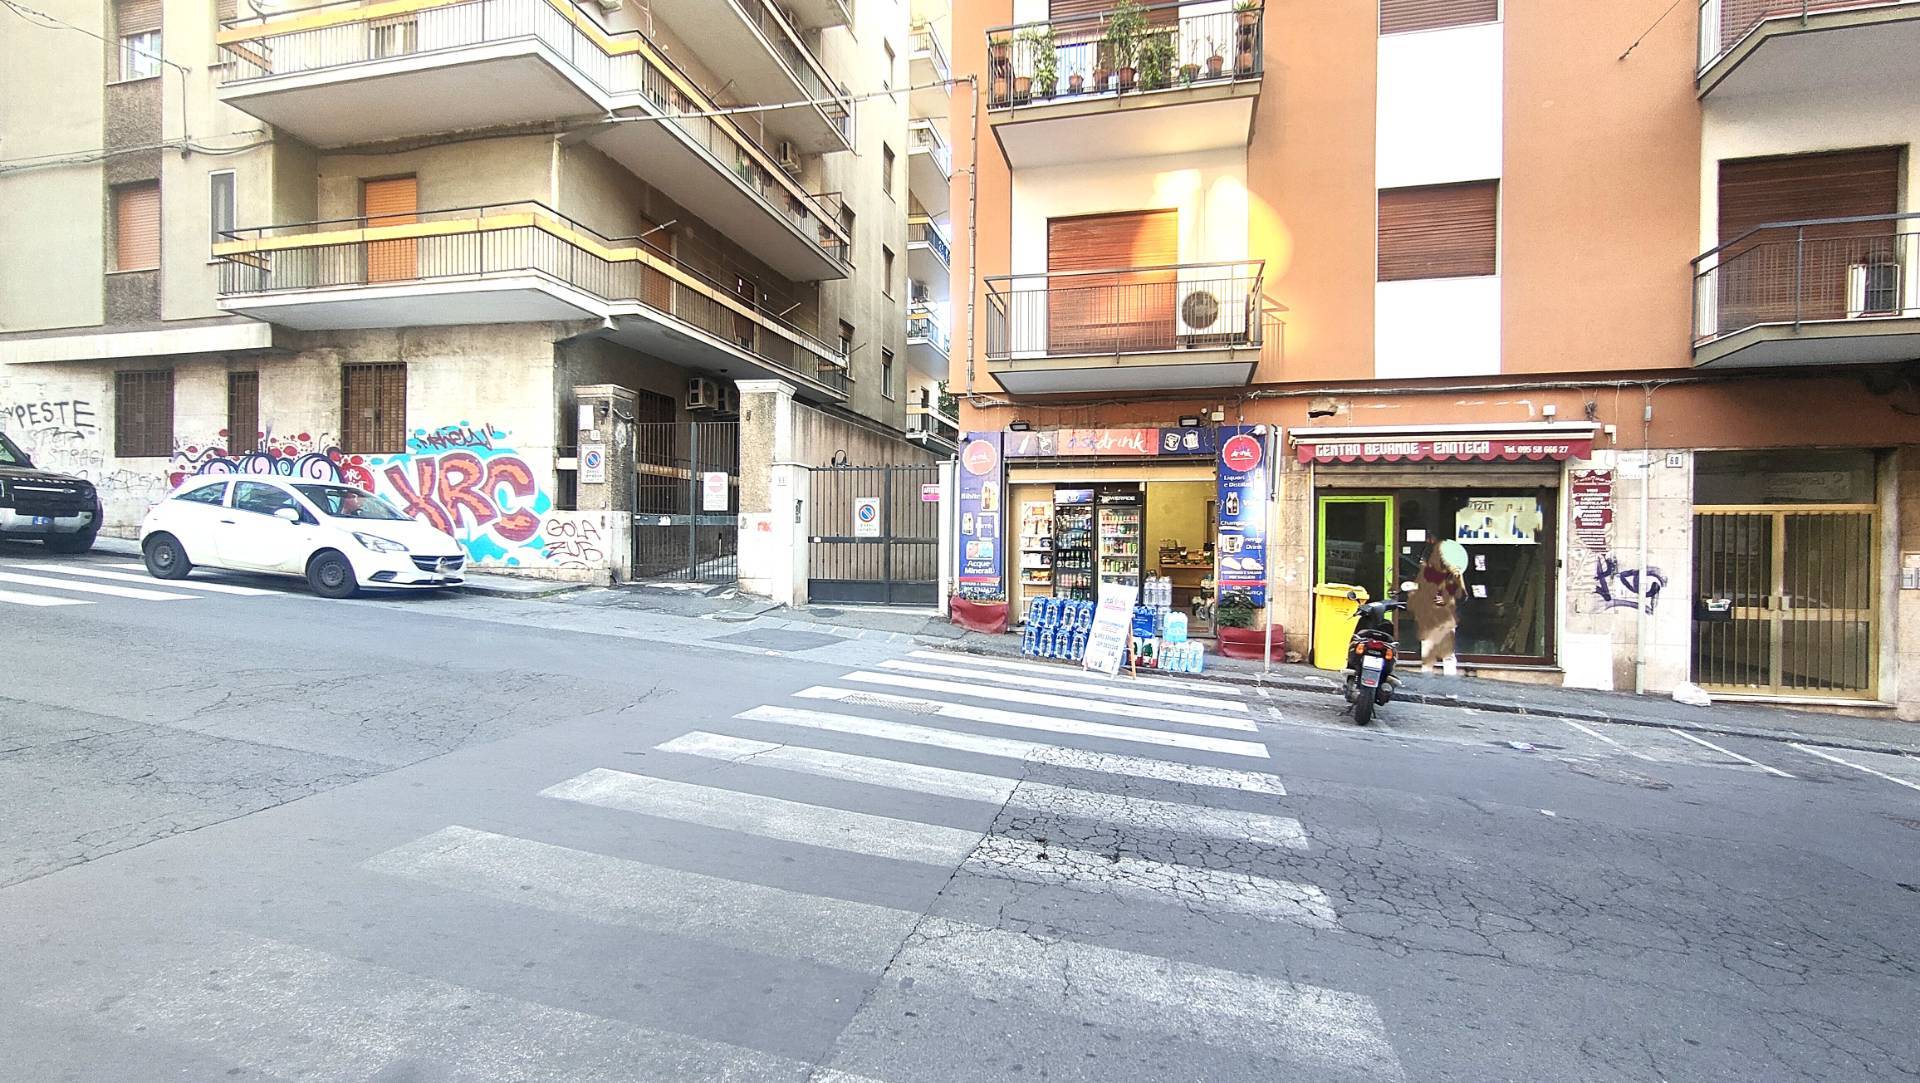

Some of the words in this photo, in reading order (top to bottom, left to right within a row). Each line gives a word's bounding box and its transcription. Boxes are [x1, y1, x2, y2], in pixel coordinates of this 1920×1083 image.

[1316, 444, 1360, 456] CENTRO
[1364, 442, 1419, 455] BEVANDE
[1434, 441, 1489, 454] ENOTECA
[384, 452, 541, 542] XRC
